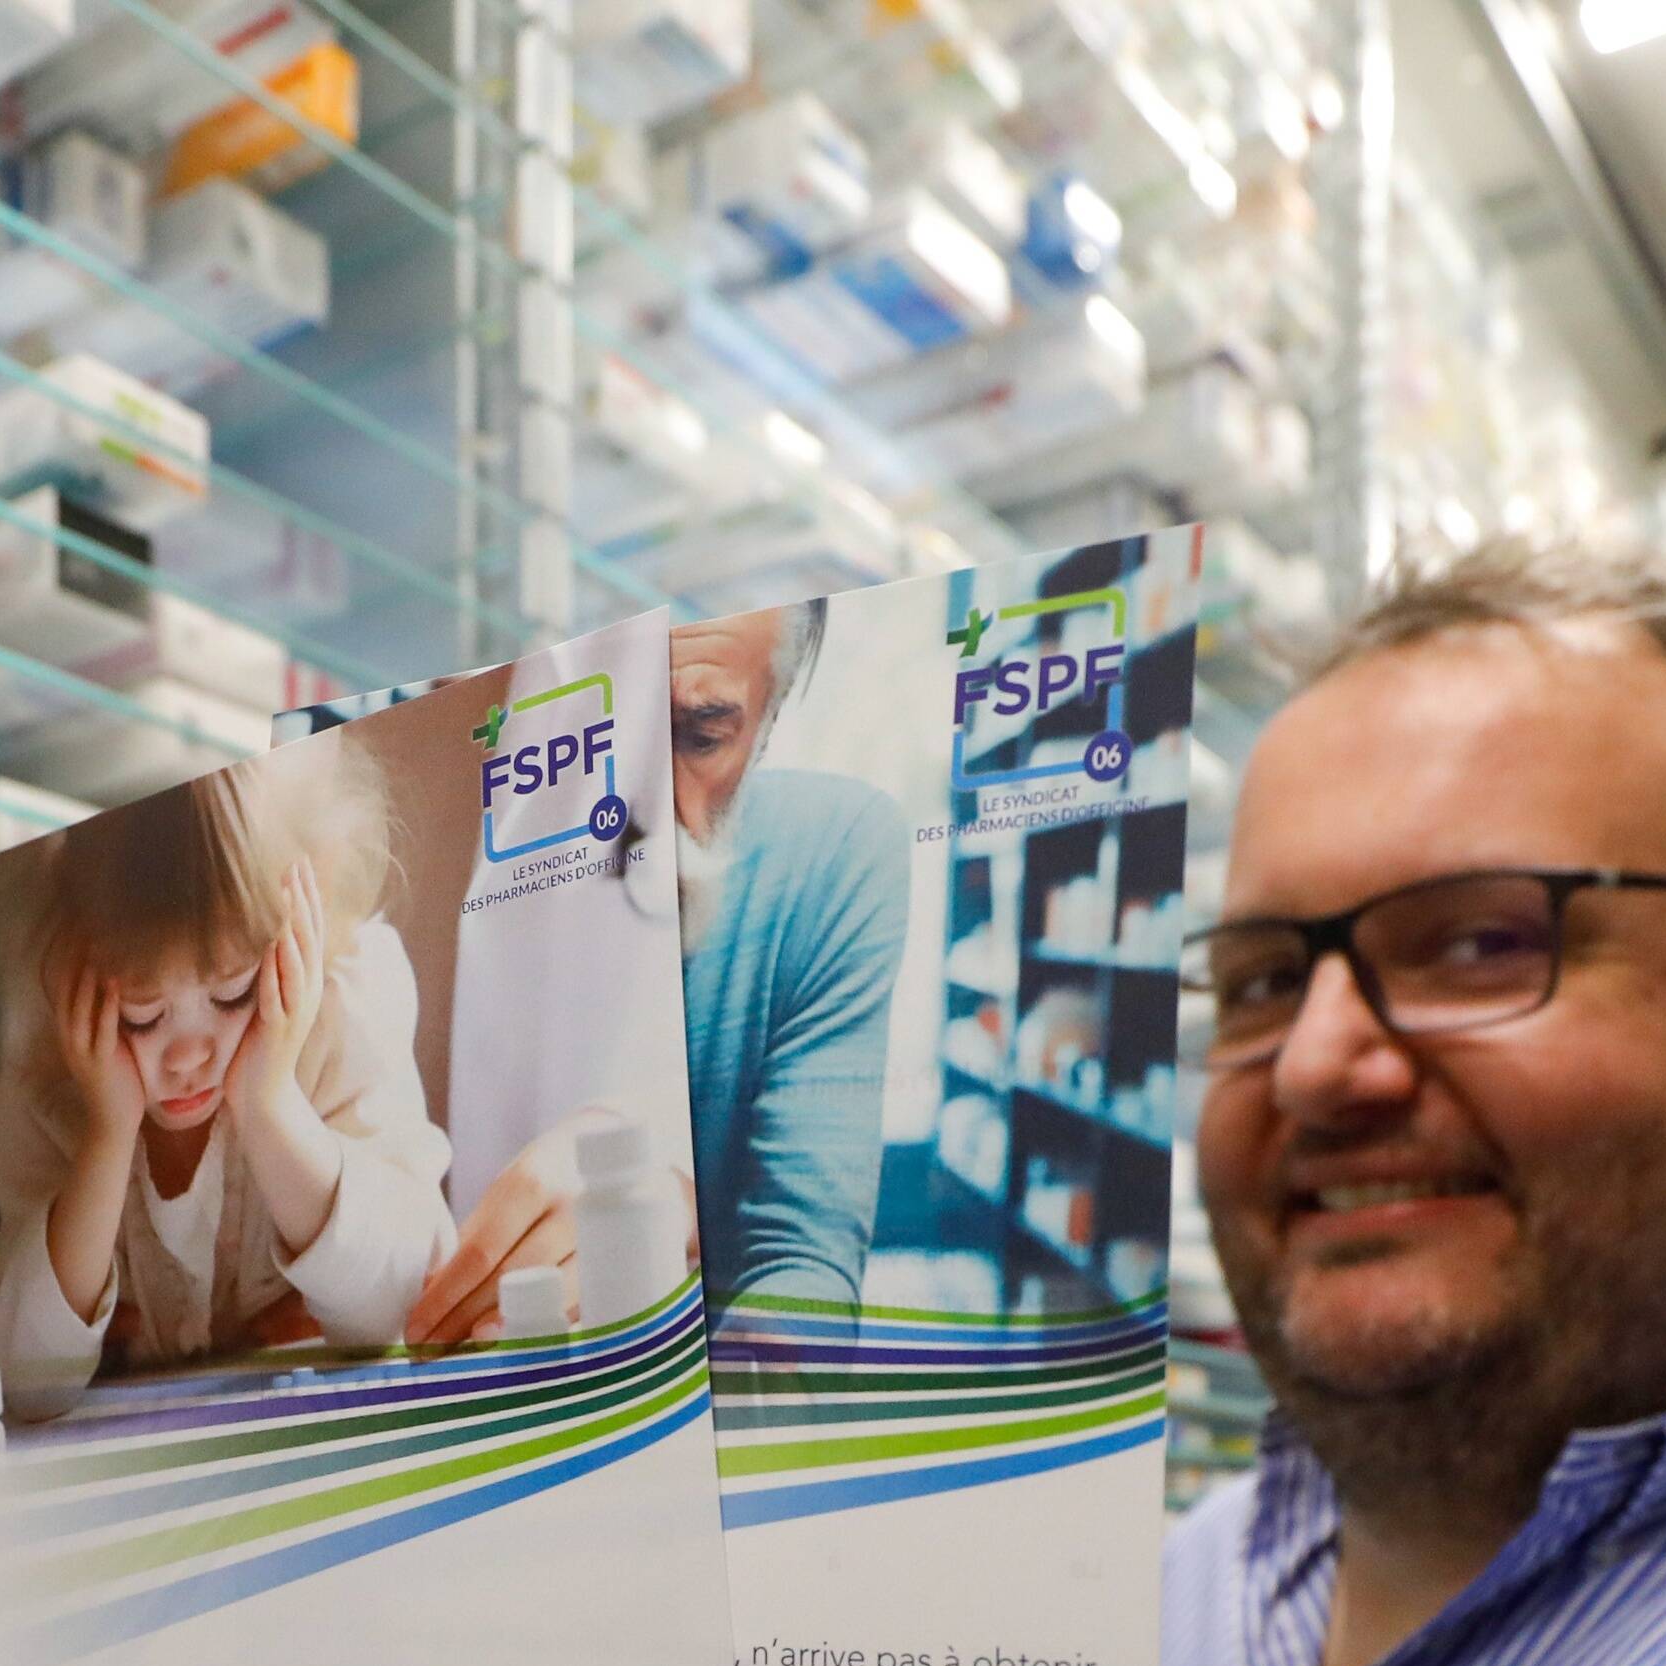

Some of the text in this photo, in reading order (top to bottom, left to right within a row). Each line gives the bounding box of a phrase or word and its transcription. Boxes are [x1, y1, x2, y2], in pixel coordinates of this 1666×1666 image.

[954, 645, 1124, 725] FSPF
[482, 719, 614, 808] FSPF
[1091, 744, 1122, 771] 06
[983, 785, 1080, 813] LE SYNDICAT
[596, 806, 619, 830] 06
[917, 828, 944, 842] DES
[947, 810, 1059, 837] PHARMACIENS
[513, 847, 588, 881] LE SYNDICAT
[462, 848, 646, 914] DES PHARMACIENS D'OFFICINE
